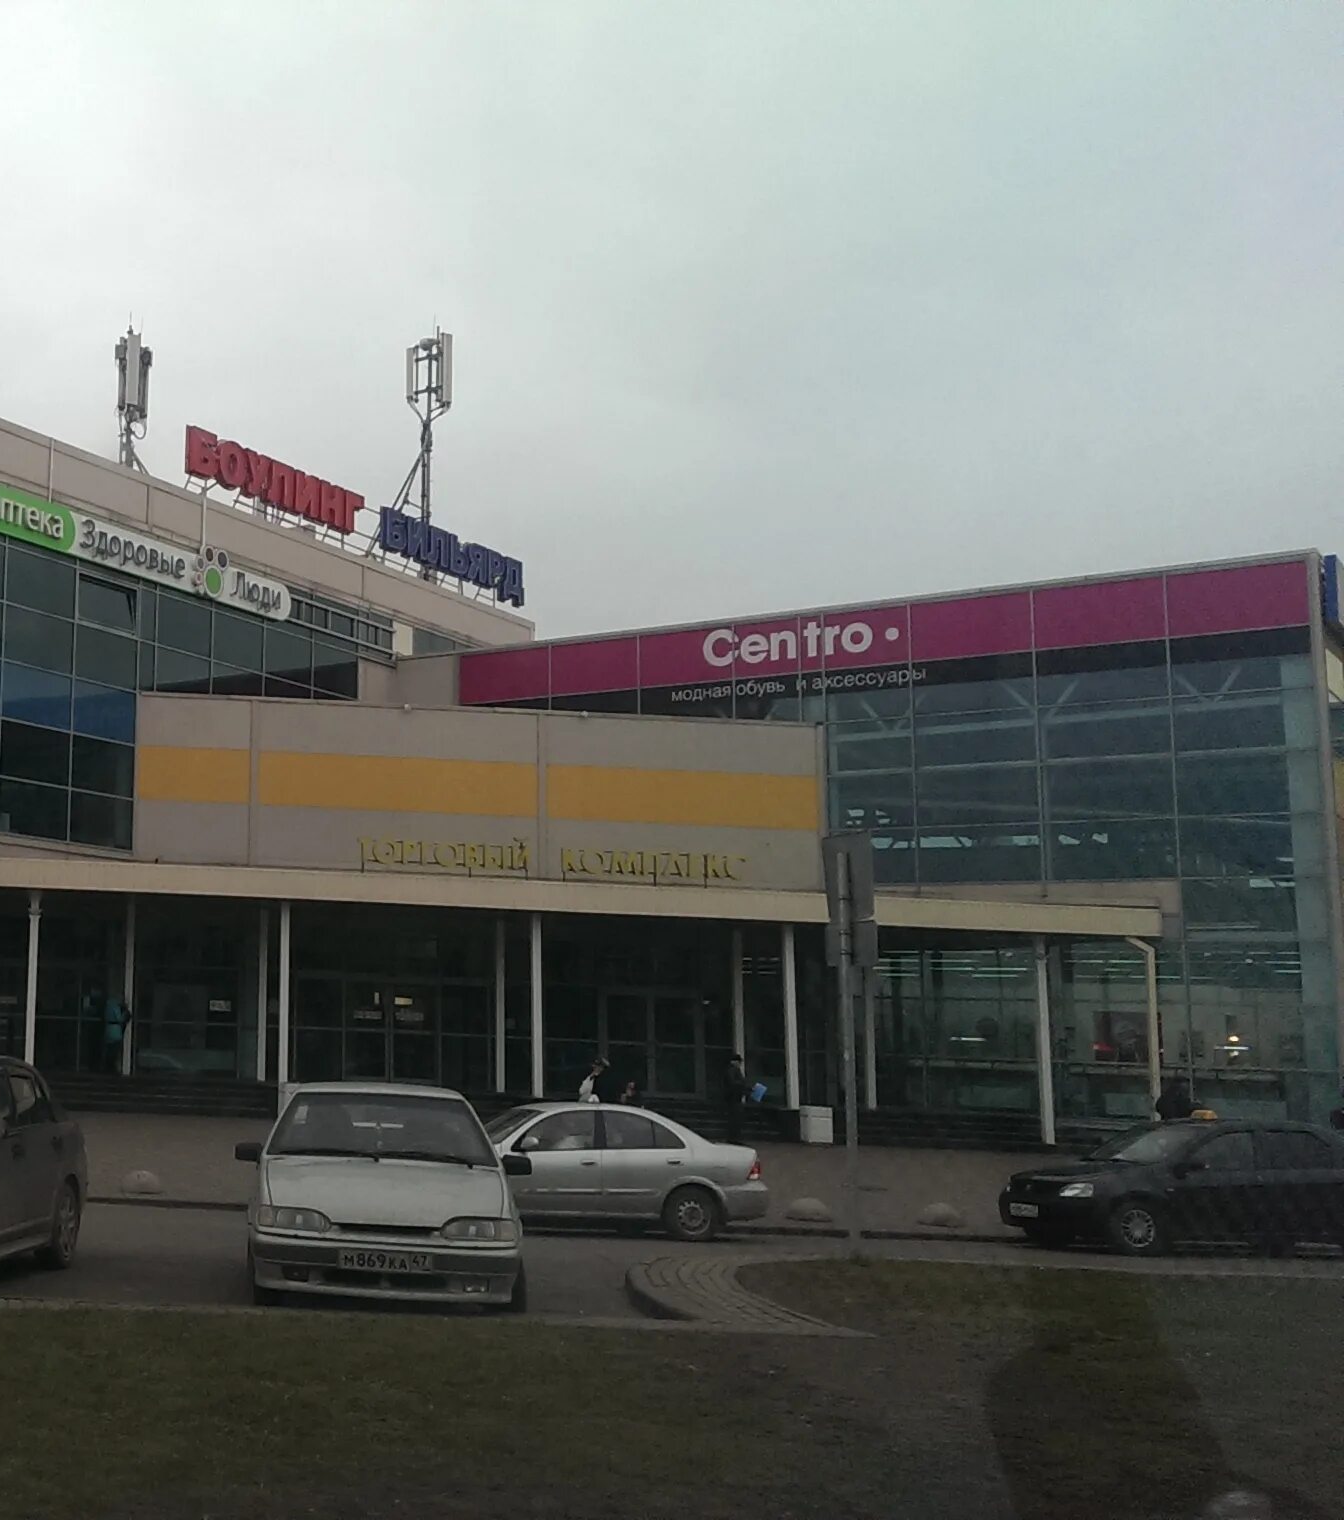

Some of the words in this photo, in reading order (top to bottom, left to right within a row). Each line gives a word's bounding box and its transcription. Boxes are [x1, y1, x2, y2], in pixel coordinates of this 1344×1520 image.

[185, 425, 365, 535] БОУЛИНГ
[80, 518, 186, 580] Здоровые
[229, 571, 283, 613] Люди
[379, 505, 525, 608] БИЛЬЯРД
[670, 684, 733, 702] модная
[735, 679, 786, 699] обувь
[795, 678, 807, 692] и
[811, 667, 927, 691] аксессуары
[702, 621, 874, 668] Centro
